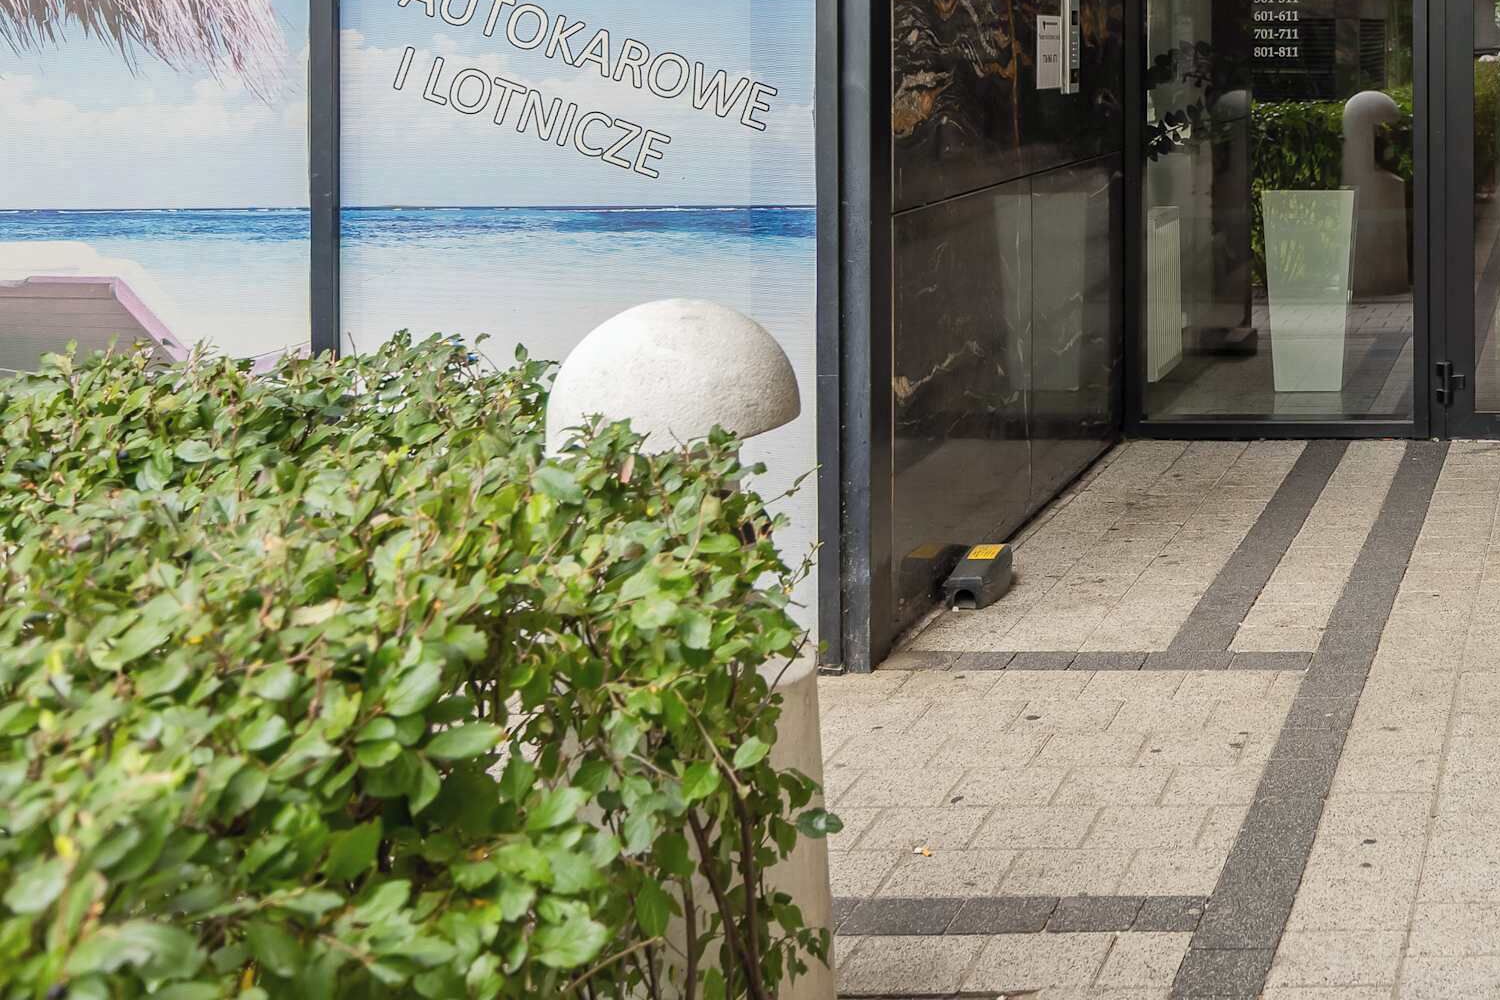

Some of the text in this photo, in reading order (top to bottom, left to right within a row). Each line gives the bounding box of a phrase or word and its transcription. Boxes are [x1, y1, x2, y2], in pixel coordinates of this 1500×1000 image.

[1253, 10, 1300, 21] 601-611
[1253, 28, 1300, 39] 701-711
[1253, 46, 1300, 57] 801-811
[393, 46, 672, 179] I LOTNICZE
